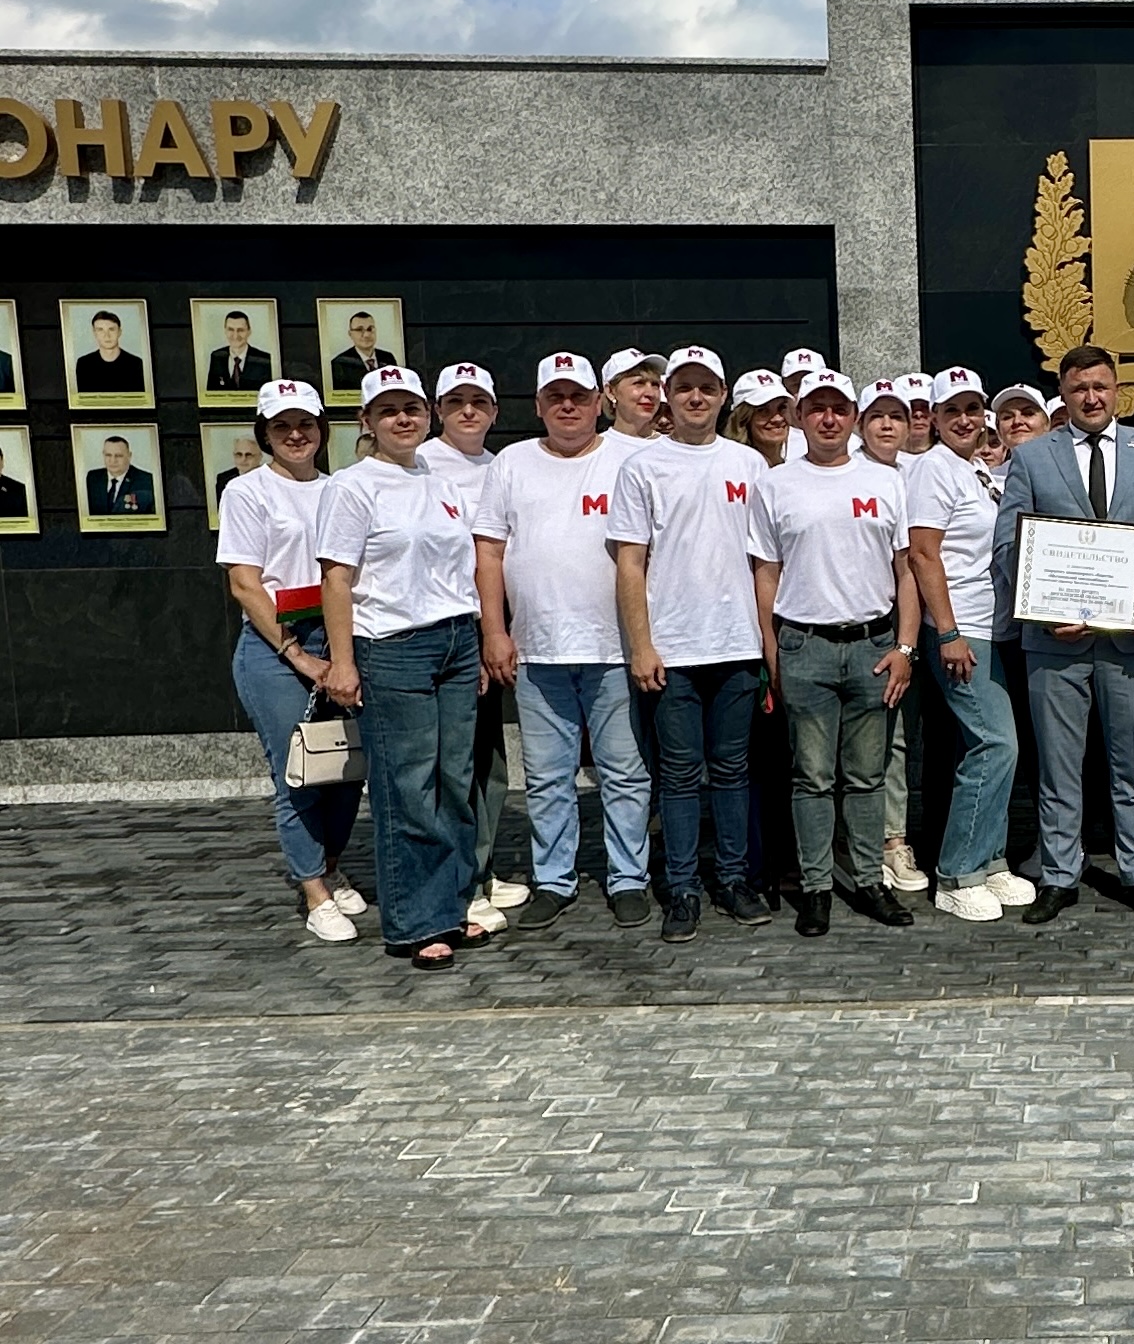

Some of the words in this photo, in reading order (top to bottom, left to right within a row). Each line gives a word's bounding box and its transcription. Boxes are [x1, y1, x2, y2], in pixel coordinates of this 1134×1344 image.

[687, 349, 704, 358] М
[797, 353, 812, 363] М
[555, 355, 574, 368] М
[379, 368, 403, 381] М
[456, 365, 477, 375] М
[757, 374, 774, 385] М
[818, 373, 835, 382] М
[949, 369, 968, 382] М
[875, 381, 894, 391] М
[908, 377, 923, 387] М
[278, 383, 297, 393] М
[725, 480, 747, 503] М
[582, 493, 608, 516] М
[852, 497, 878, 518] М
